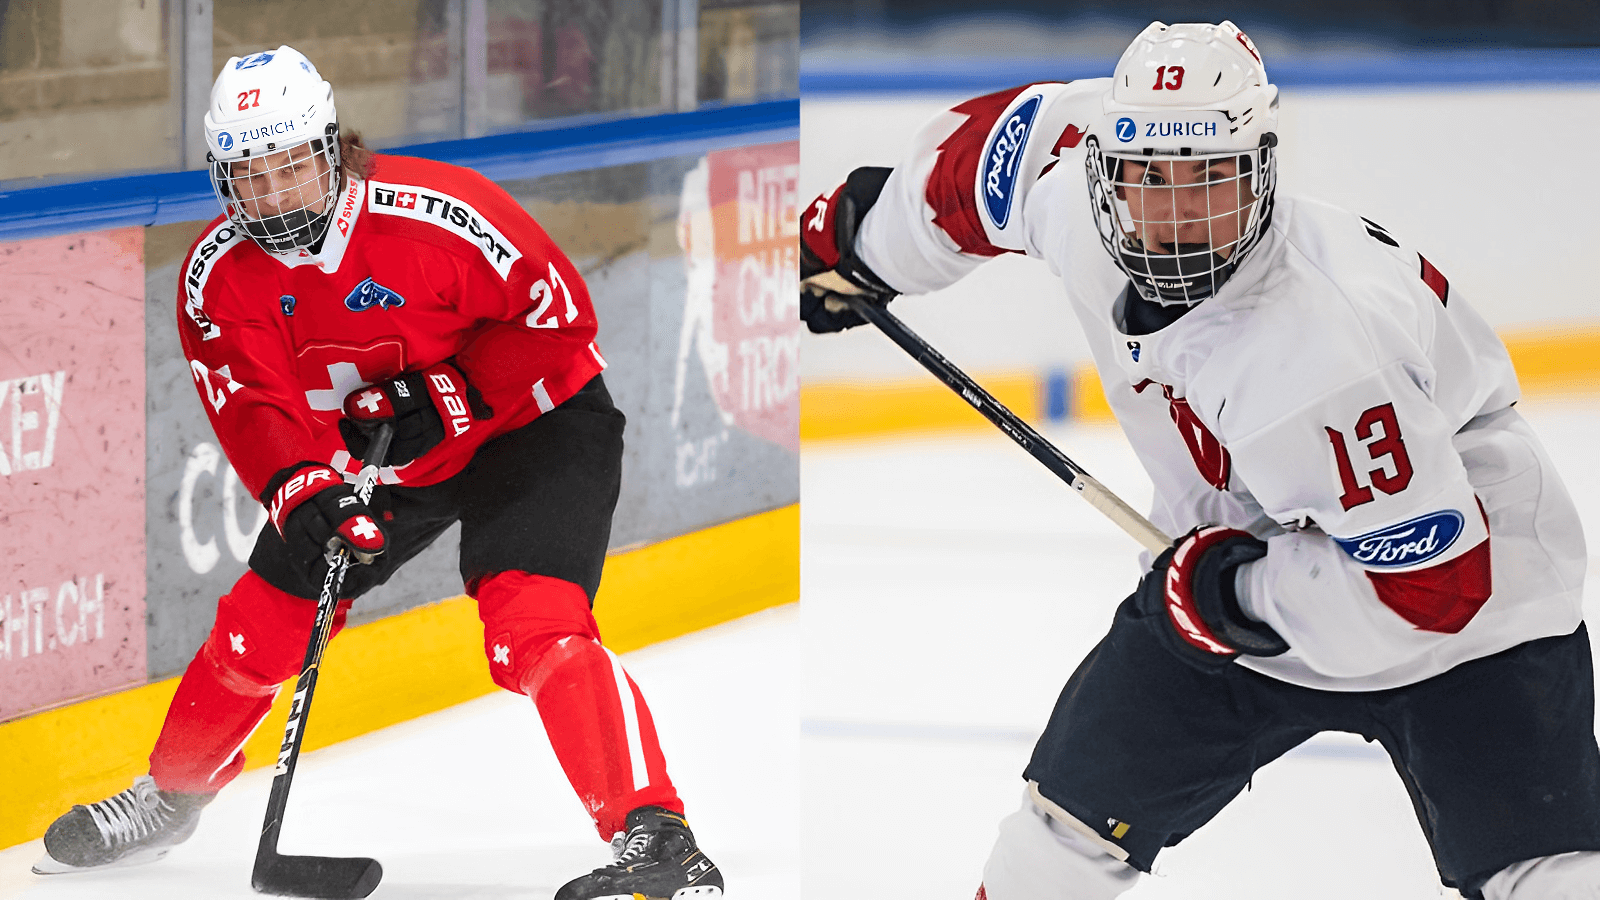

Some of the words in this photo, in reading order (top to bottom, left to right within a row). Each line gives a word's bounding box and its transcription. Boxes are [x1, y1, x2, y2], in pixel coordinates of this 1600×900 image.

[1152, 66, 1185, 91] 13
[237, 89, 261, 111] 27
[240, 120, 295, 143] ZURICH
[1146, 122, 1216, 137] ZURICH
[985, 114, 1027, 200] Ford
[343, 180, 358, 218] SWISS
[421, 195, 512, 263] TISSOT
[1324, 402, 1414, 512] 13
[1353, 524, 1439, 563] Ford
